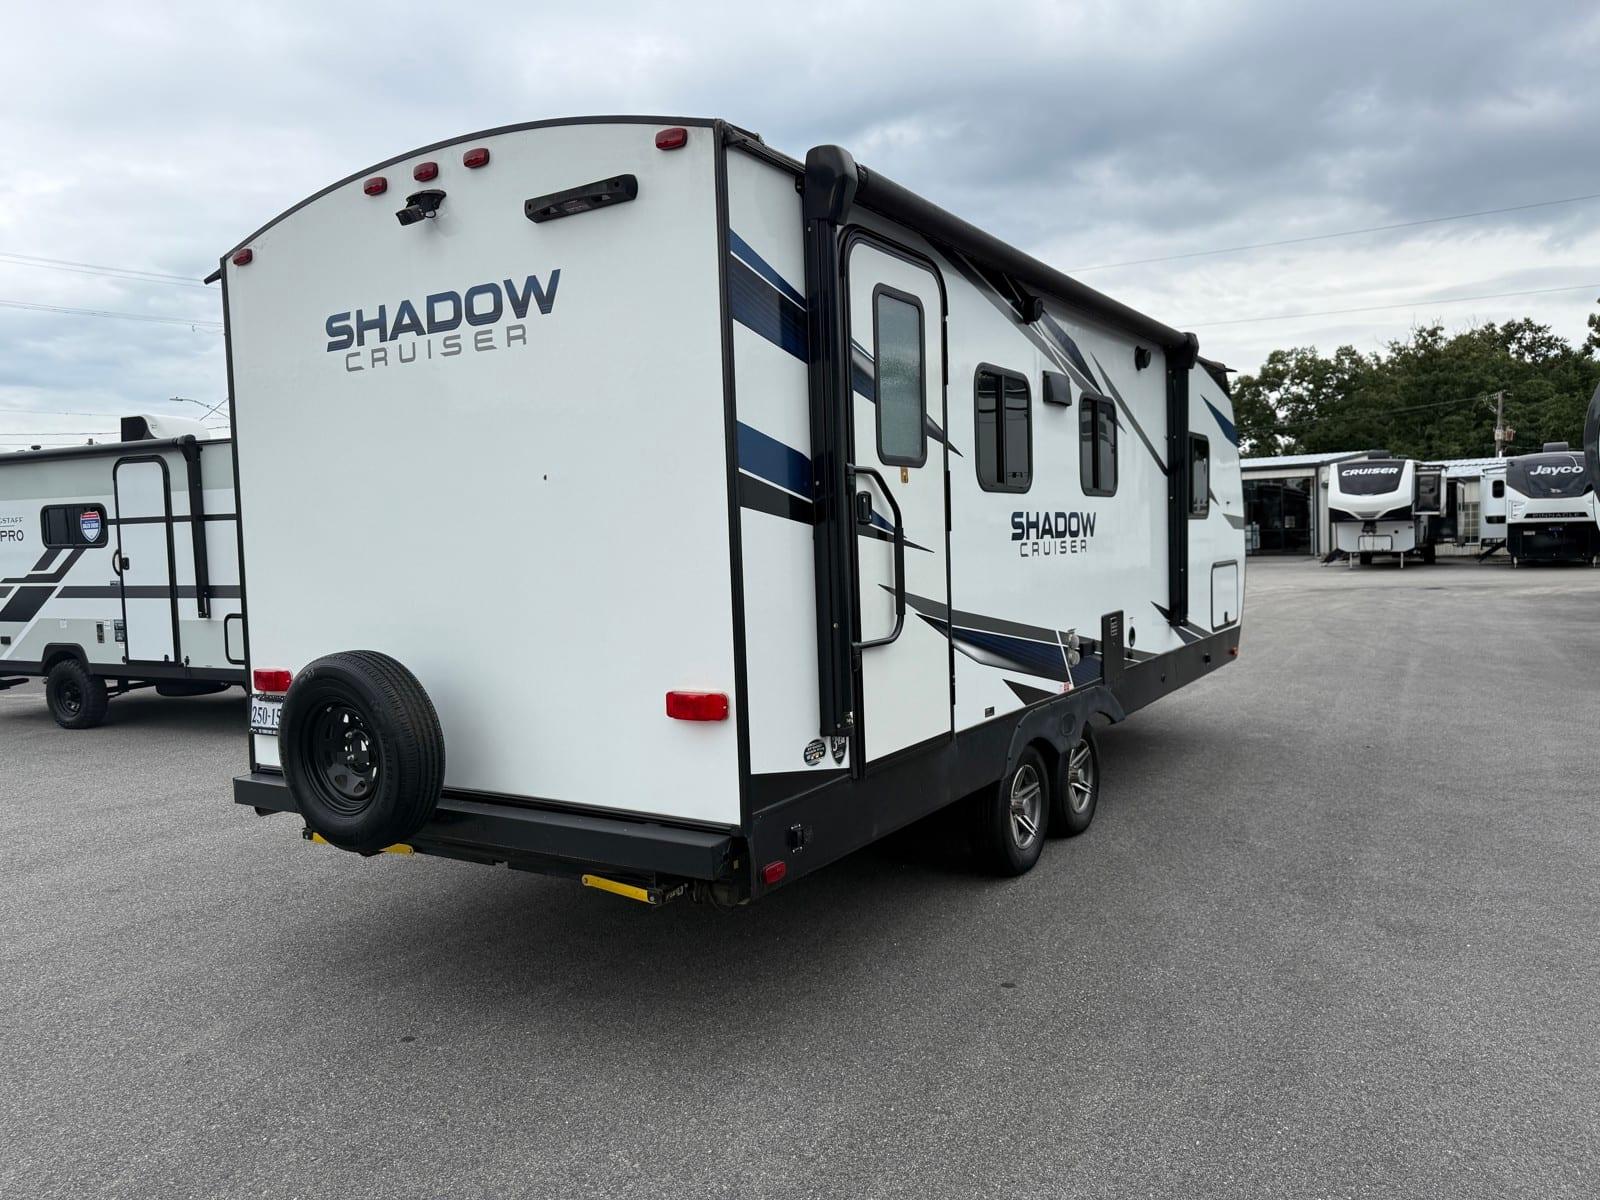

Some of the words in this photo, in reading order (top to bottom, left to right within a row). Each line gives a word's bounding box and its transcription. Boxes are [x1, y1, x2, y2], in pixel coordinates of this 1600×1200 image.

[325, 268, 561, 352] SHADOW
[345, 323, 527, 372] CRUISER
[1341, 467, 1399, 477] CRUISER
[1529, 465, 1584, 476] Jayco
[0, 516, 24, 524] STAFF
[1010, 511, 1097, 541] SHADOW
[1020, 539, 1088, 558] CRUISER
